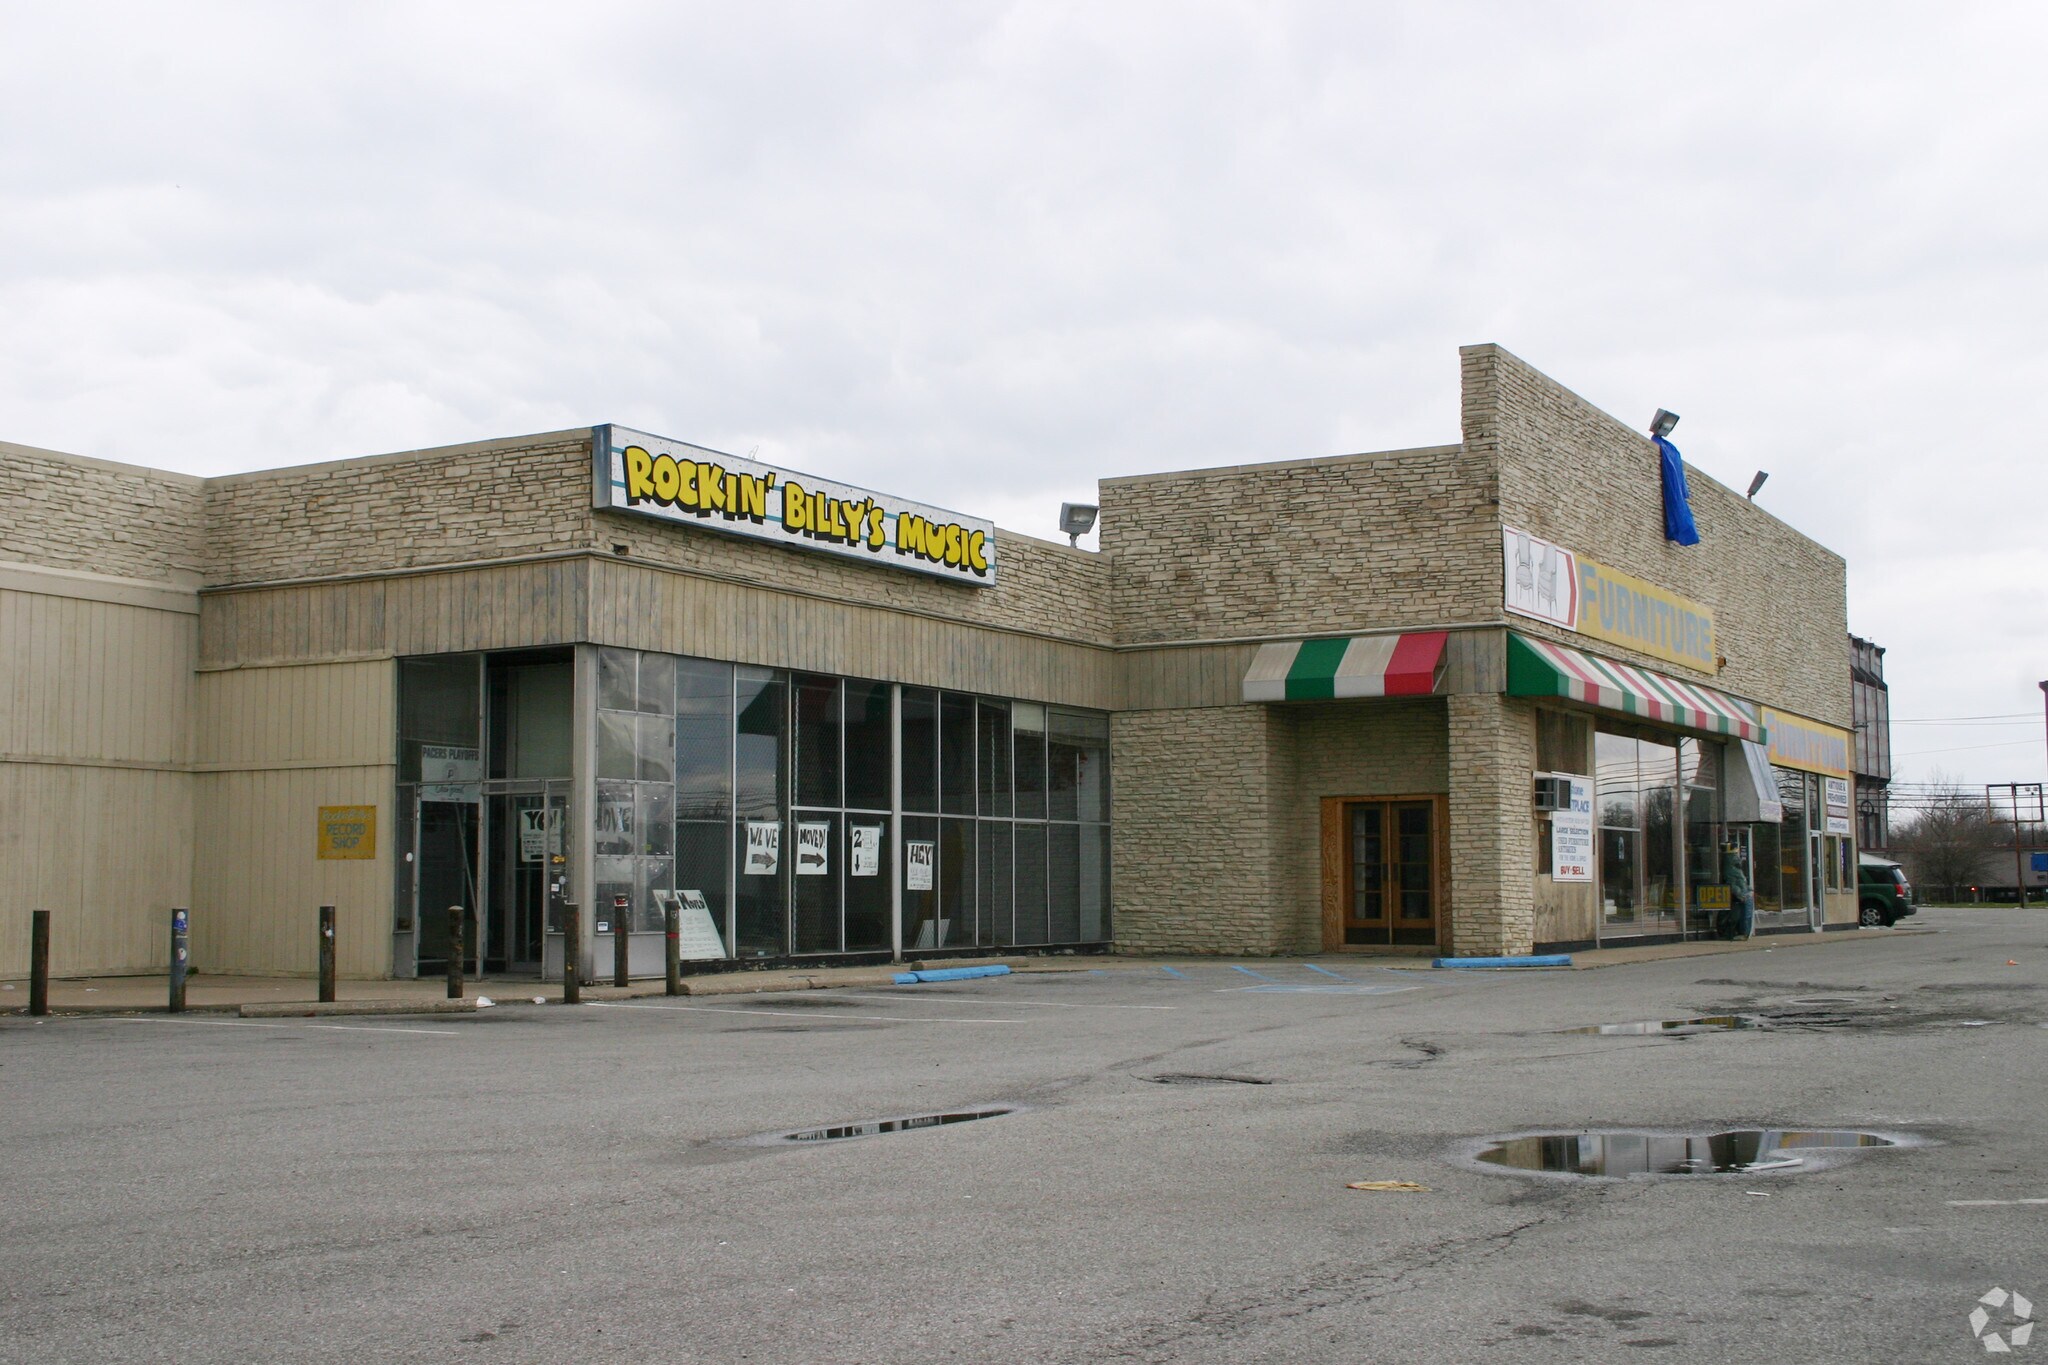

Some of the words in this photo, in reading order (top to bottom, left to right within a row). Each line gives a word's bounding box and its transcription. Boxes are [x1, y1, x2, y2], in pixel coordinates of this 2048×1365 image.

[623, 444, 776, 525] ROCKIN'
[782, 480, 886, 552] BILLY'S
[896, 511, 988, 577] MUSIC
[1578, 562, 1713, 663] FURNITURE
[1763, 711, 1847, 771] FURNITURE
[422, 747, 447, 759] PACERS
[448, 748, 479, 761] PLAYOFFS
[326, 823, 366, 835] RECORD
[853, 829, 863, 848] 2
[332, 836, 359, 849] SHOP
